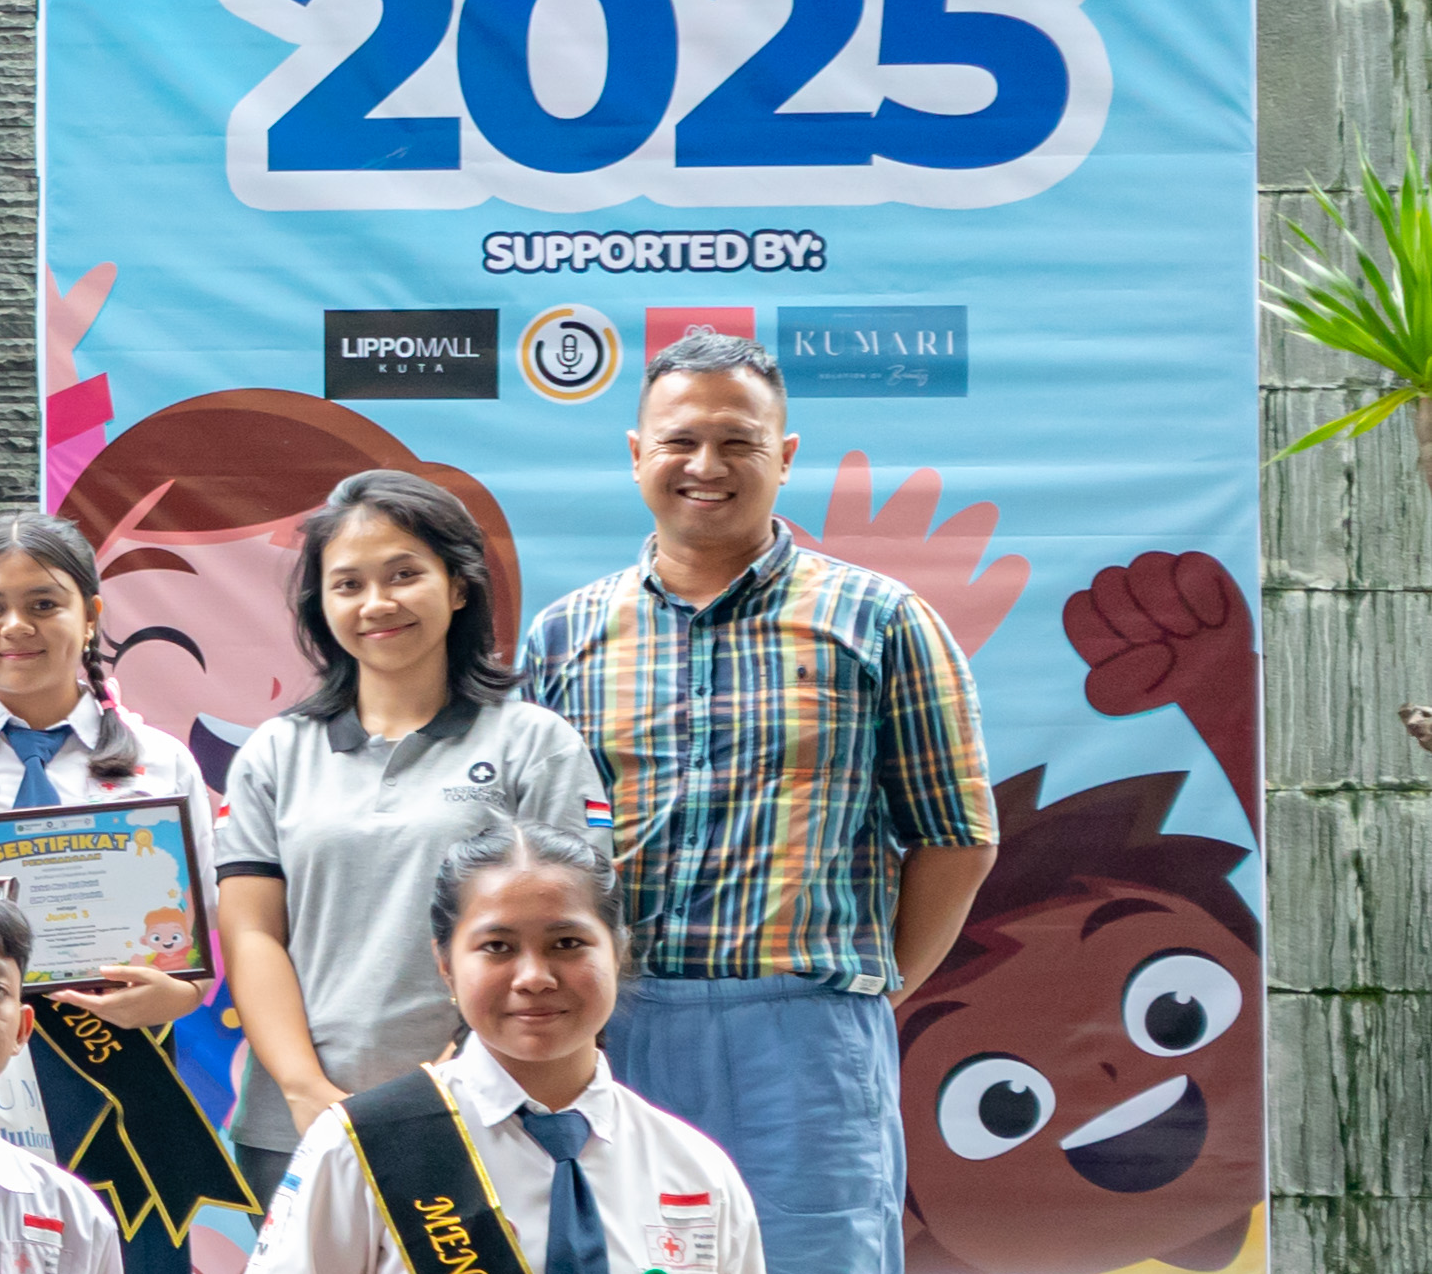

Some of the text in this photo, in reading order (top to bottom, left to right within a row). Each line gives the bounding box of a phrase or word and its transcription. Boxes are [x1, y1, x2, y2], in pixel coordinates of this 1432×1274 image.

[483, 230, 825, 274] SUPPORTED BY:
[793, 330, 955, 356] KUMARI
[379, 364, 444, 373] KUTA
